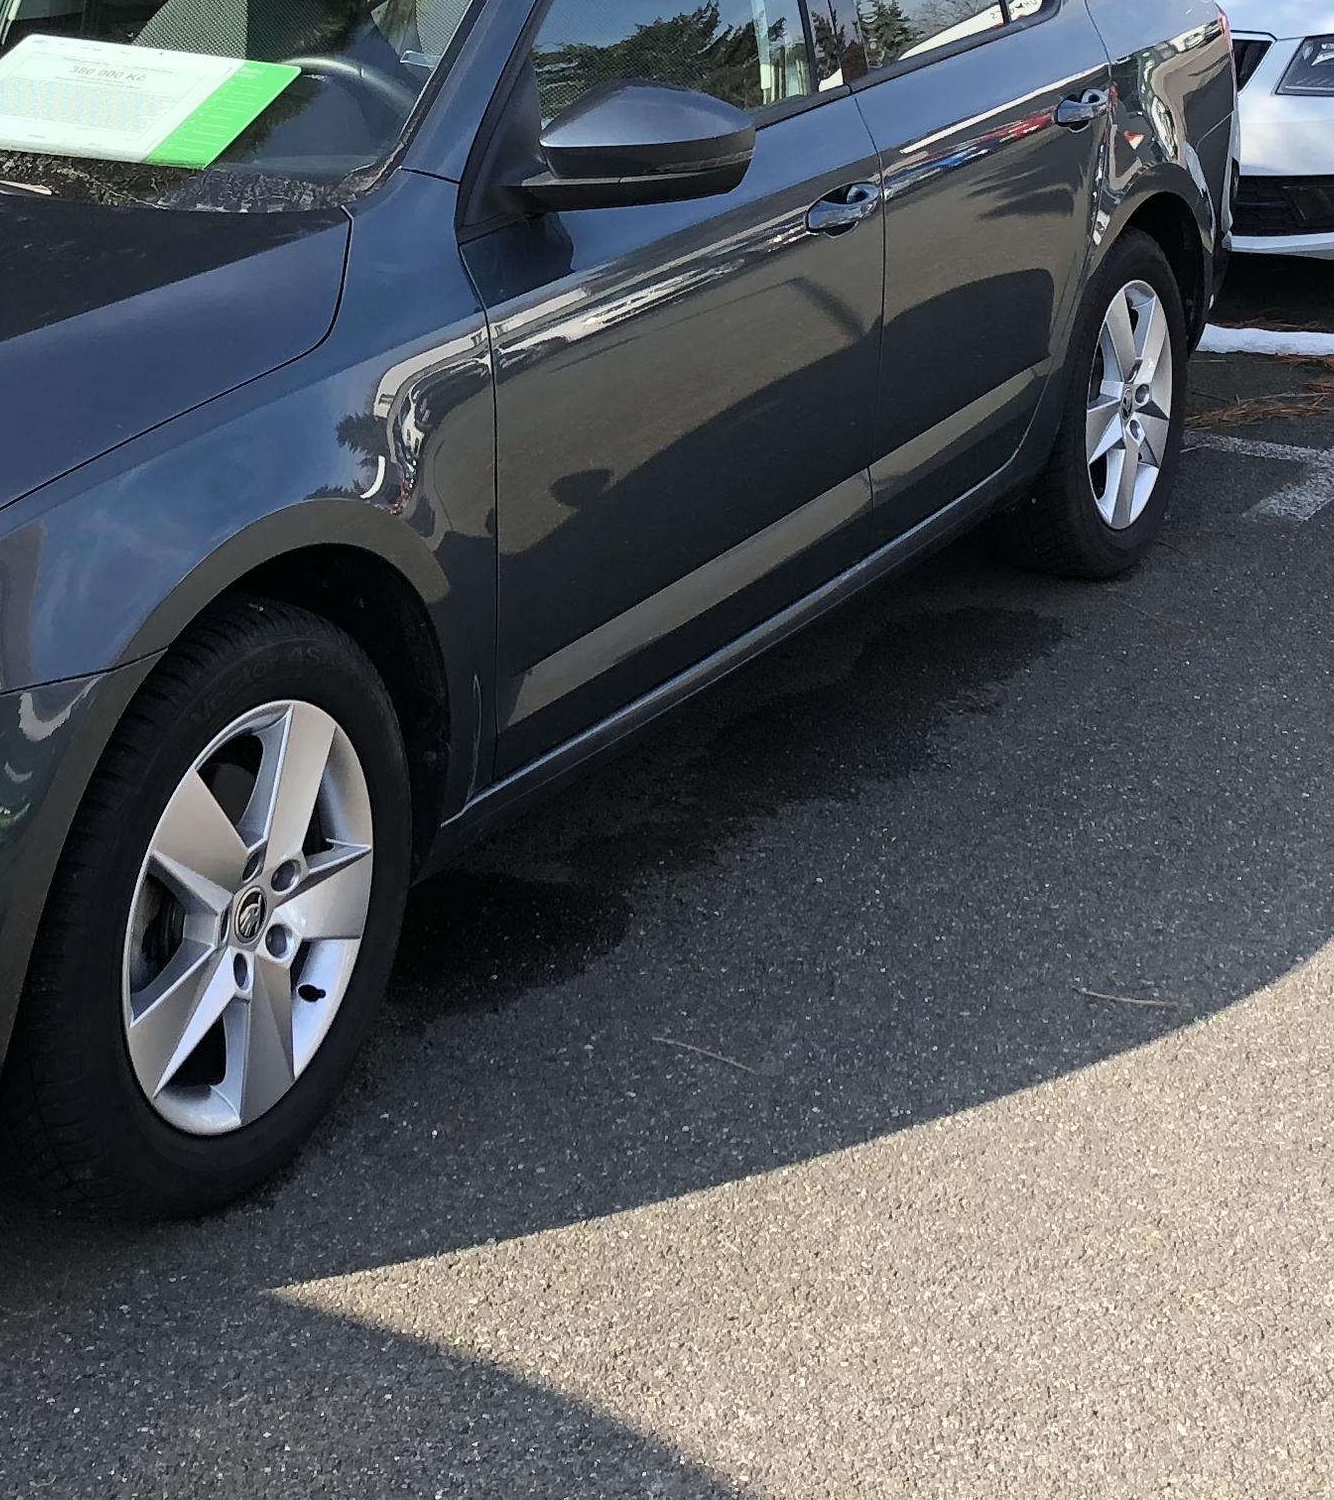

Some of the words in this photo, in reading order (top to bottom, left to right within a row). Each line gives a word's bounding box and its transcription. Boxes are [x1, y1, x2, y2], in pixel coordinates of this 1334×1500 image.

[68, 65, 96, 74] 380
[99, 68, 124, 78] 000
[126, 72, 147, 82] Kč
